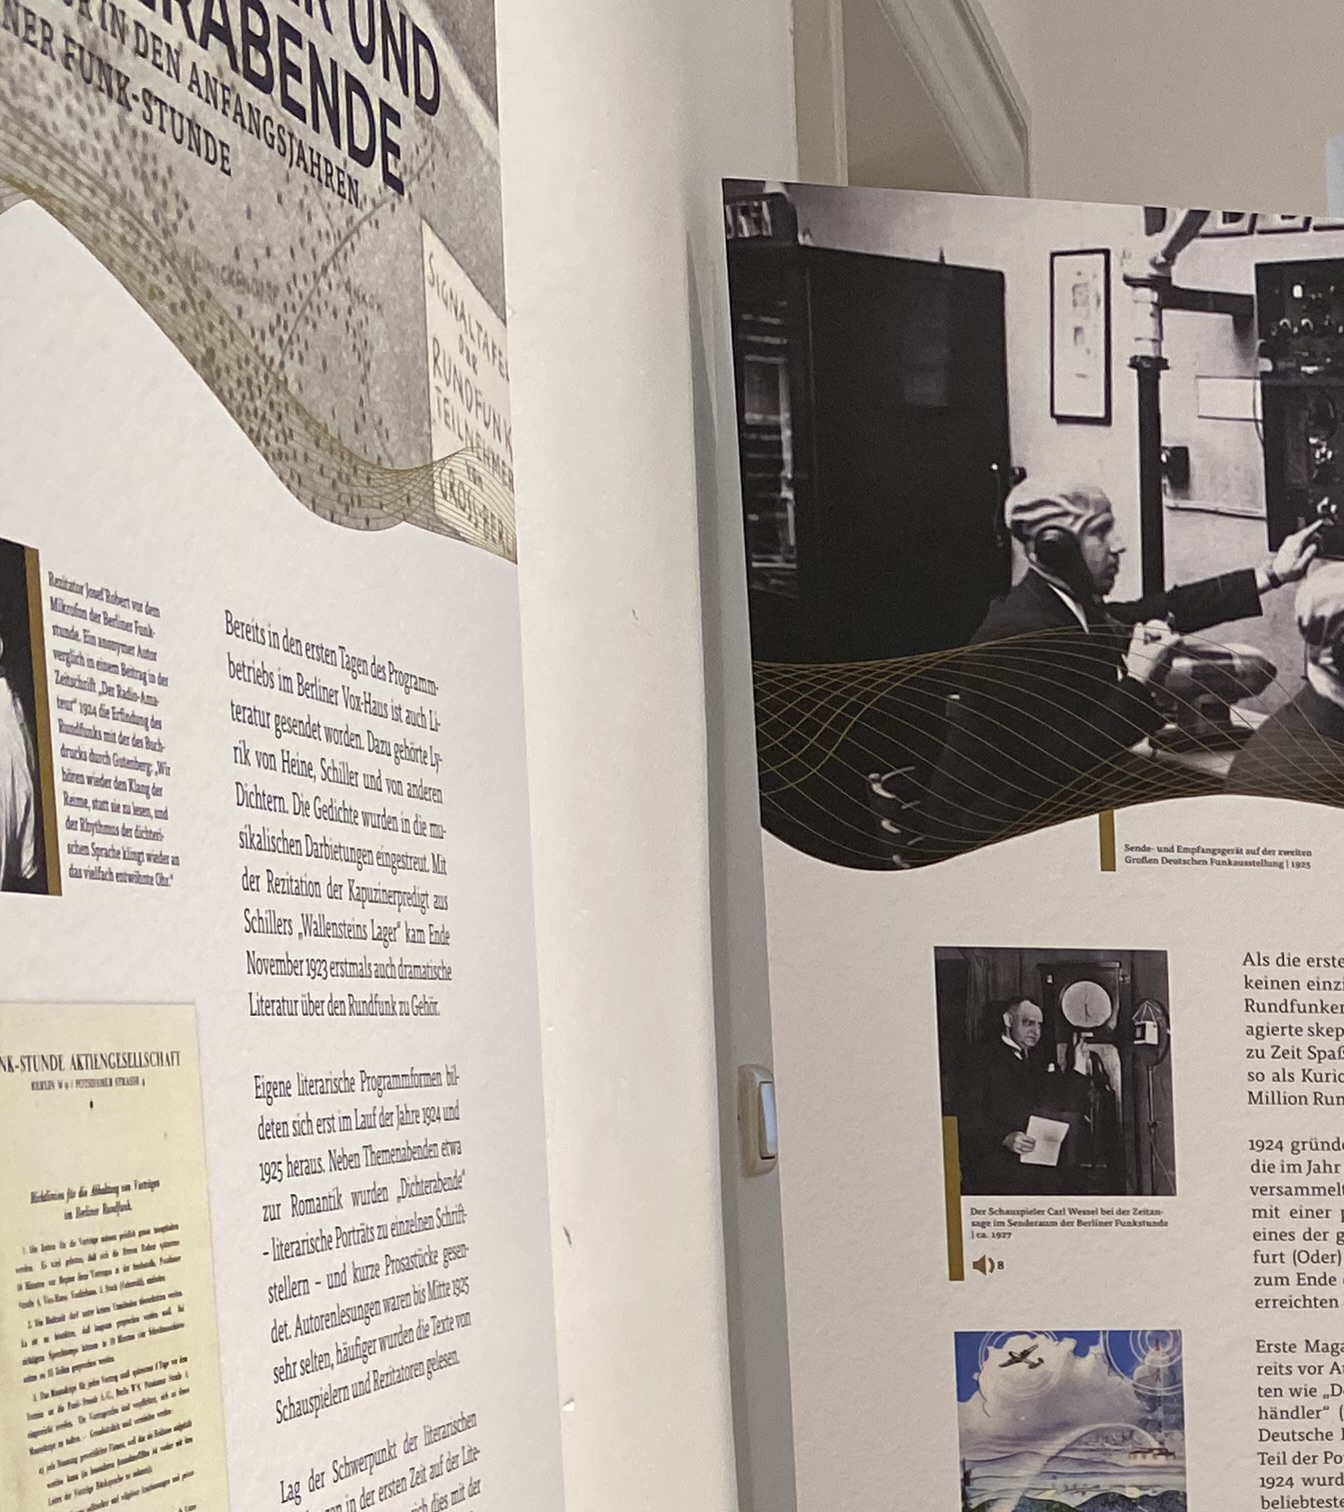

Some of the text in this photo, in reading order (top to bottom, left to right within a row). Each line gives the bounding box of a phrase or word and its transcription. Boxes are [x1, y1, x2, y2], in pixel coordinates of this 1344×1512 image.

[348, 0, 440, 116] UND
[62, 33, 232, 177] FUNK-STUNDE
[133, 19, 181, 84] DEN
[187, 61, 360, 208] ANFANGSJAHREN
[224, 608, 266, 646] Bereits
[267, 623, 281, 651] in
[282, 626, 303, 657] den
[304, 641, 338, 667] ersten
[338, 644, 369, 680] Tagen
[370, 654, 387, 682] des
[226, 652, 275, 690] betriebs
[277, 666, 294, 695] im
[296, 671, 339, 707] Berliner
[341, 684, 389, 720] Vox-Haus
[390, 698, 404, 724] ist
[405, 705, 428, 730] auch
[1242, 951, 1270, 967] Als
[1275, 952, 1301, 968] die
[1243, 974, 1301, 991] keinen
